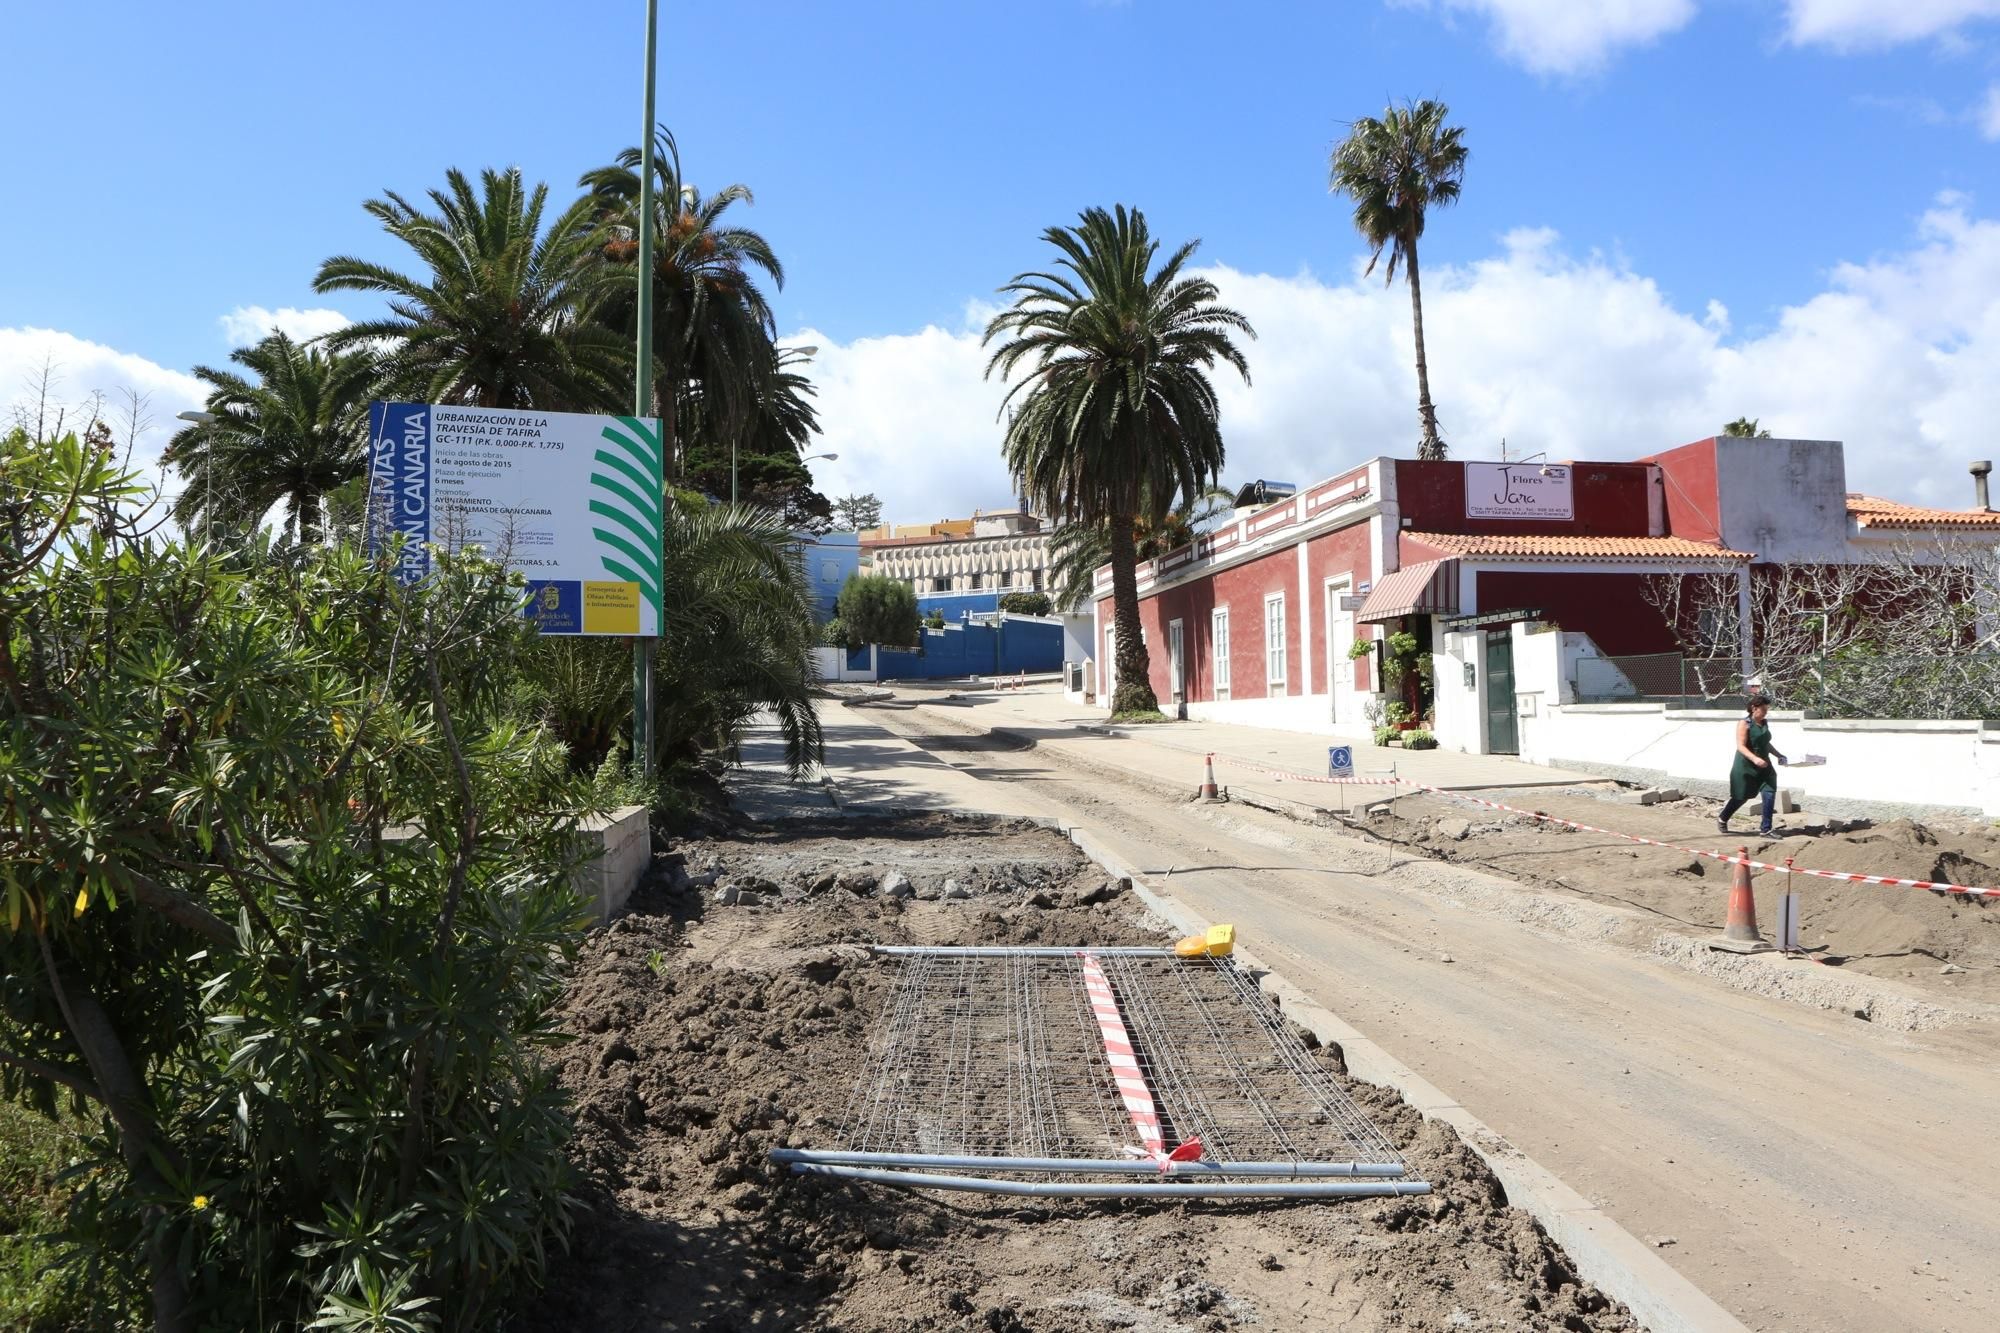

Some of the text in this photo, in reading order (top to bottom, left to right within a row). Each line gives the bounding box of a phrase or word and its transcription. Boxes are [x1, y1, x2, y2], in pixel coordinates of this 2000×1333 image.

[436, 412, 548, 427] URBANIZACIÓN DE LA
[436, 423, 541, 438] TRAVESÍA DE TAFIRA
[435, 434, 472, 445] GC-111
[475, 438, 494, 447] (P.K.
[540, 441, 564, 451] 1,775)
[435, 449, 456, 457] Inicio
[458, 449, 468, 457] de
[470, 450, 481, 458] las
[442, 458, 452, 466] de
[454, 459, 481, 468] agosto
[482, 459, 492, 467] de
[435, 468, 455, 476] Plazo
[468, 470, 501, 479] ejecución
[1512, 475, 1543, 484] Flores
[1494, 466, 1536, 505] Jara
[402, 411, 426, 588] GRAN CANARIA
[435, 497, 492, 506] AYUNTAMIENTO
[500, 507, 521, 515] GRAN
[521, 508, 553, 516] CANARIA
